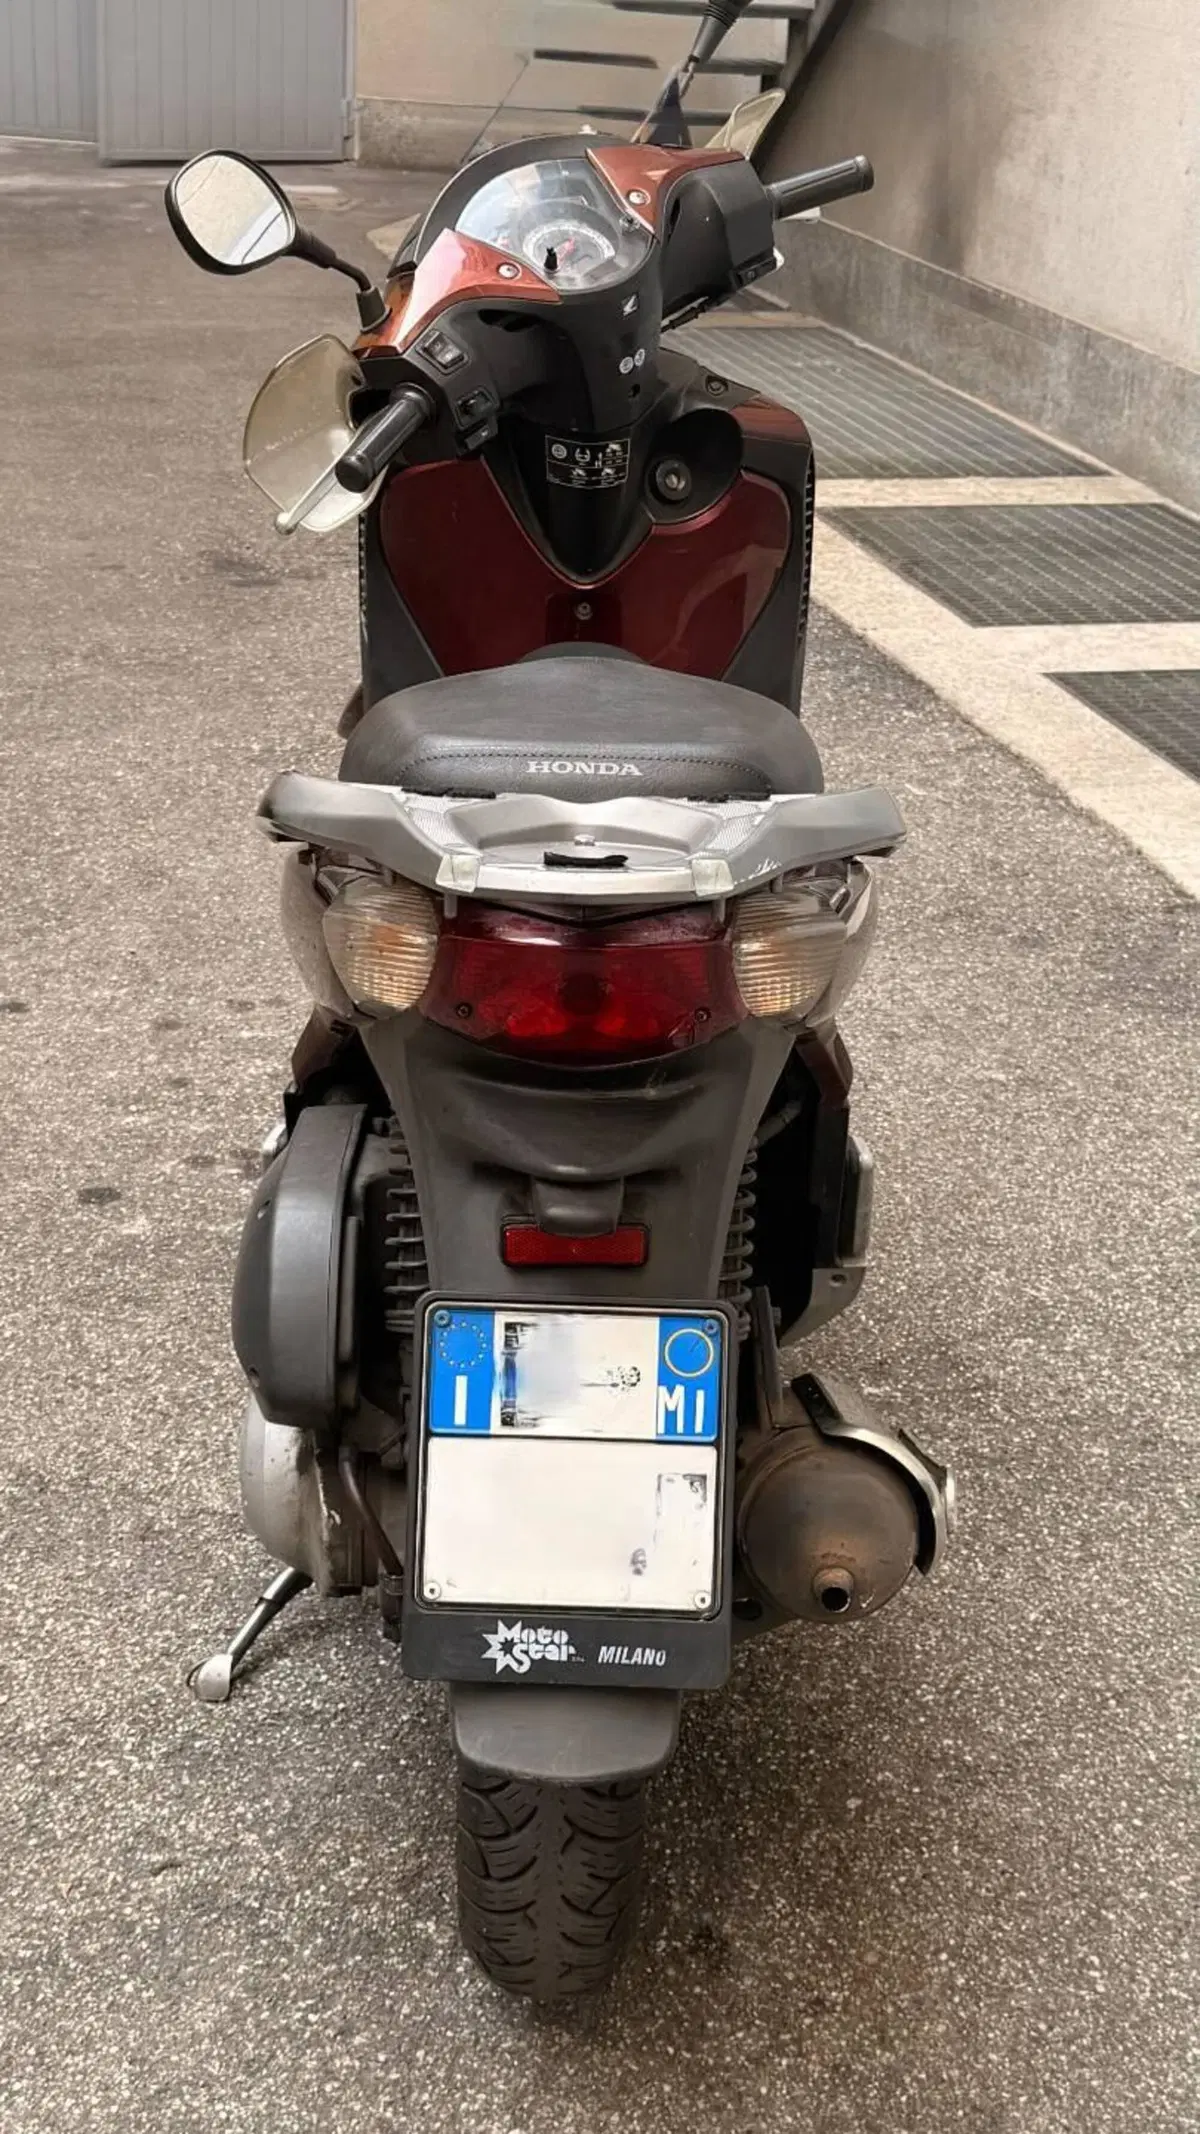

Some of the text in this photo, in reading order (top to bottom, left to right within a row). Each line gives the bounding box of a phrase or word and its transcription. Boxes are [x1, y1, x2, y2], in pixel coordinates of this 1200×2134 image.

[526, 760, 643, 775] HONDA
[453, 1375, 468, 1425] I
[656, 1384, 705, 1434] MI
[497, 1619, 569, 1645] Moto
[504, 1643, 576, 1674] Star
[598, 1645, 666, 1667] MILANO
